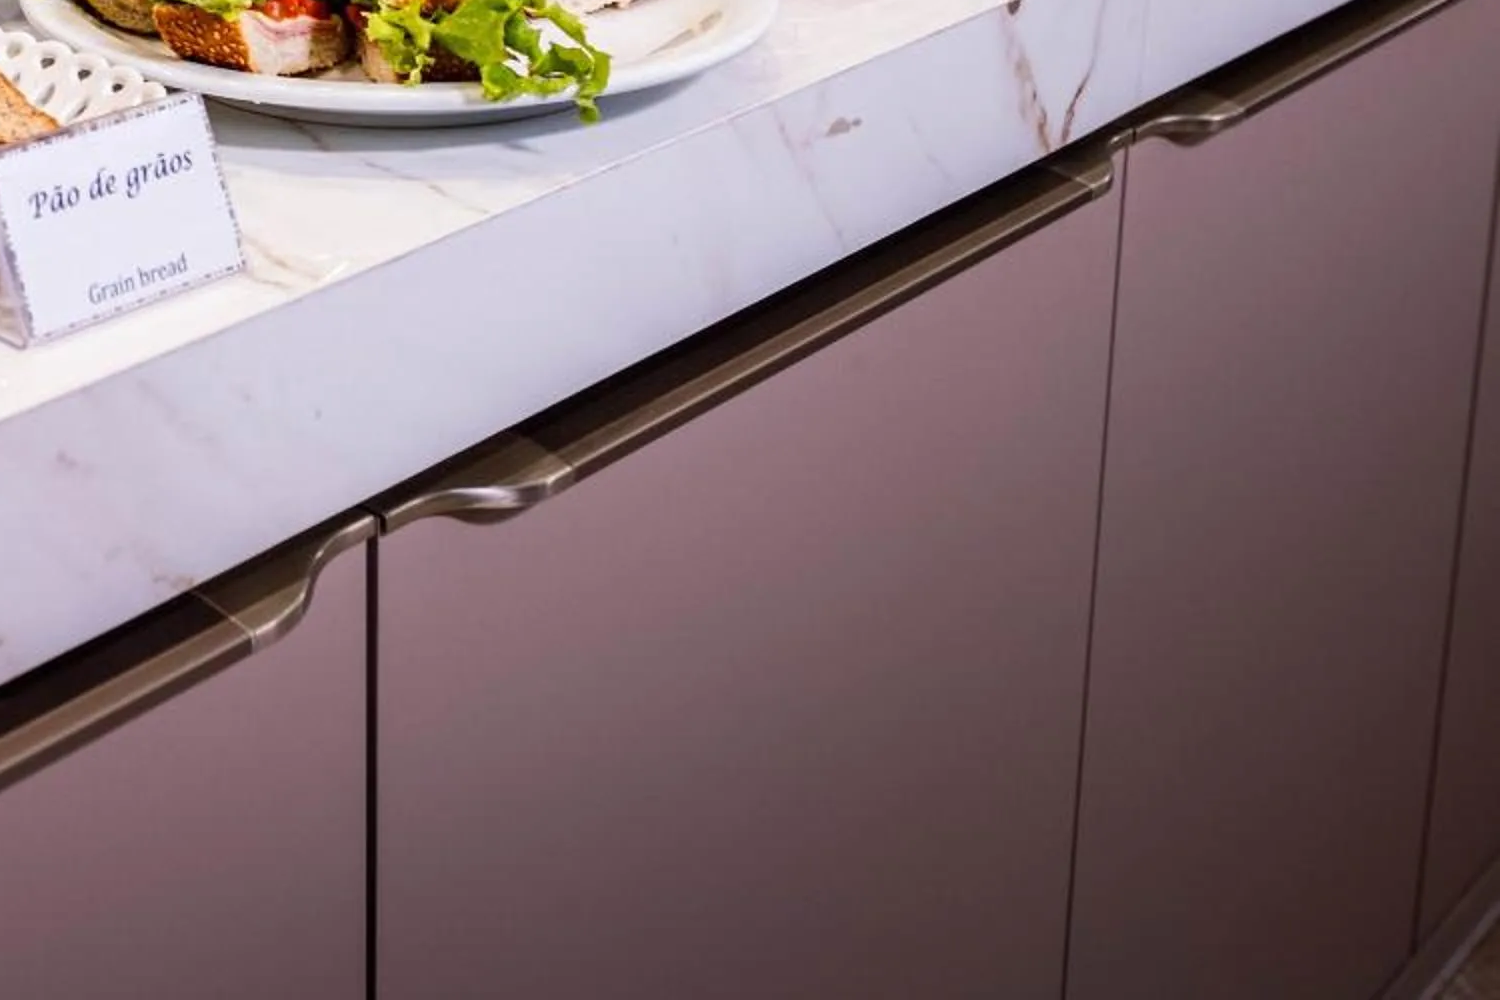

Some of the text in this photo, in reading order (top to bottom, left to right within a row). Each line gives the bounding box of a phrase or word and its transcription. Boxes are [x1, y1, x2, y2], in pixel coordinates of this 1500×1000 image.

[28, 149, 194, 220] Pão de grãos
[88, 251, 188, 306] Grain bread
